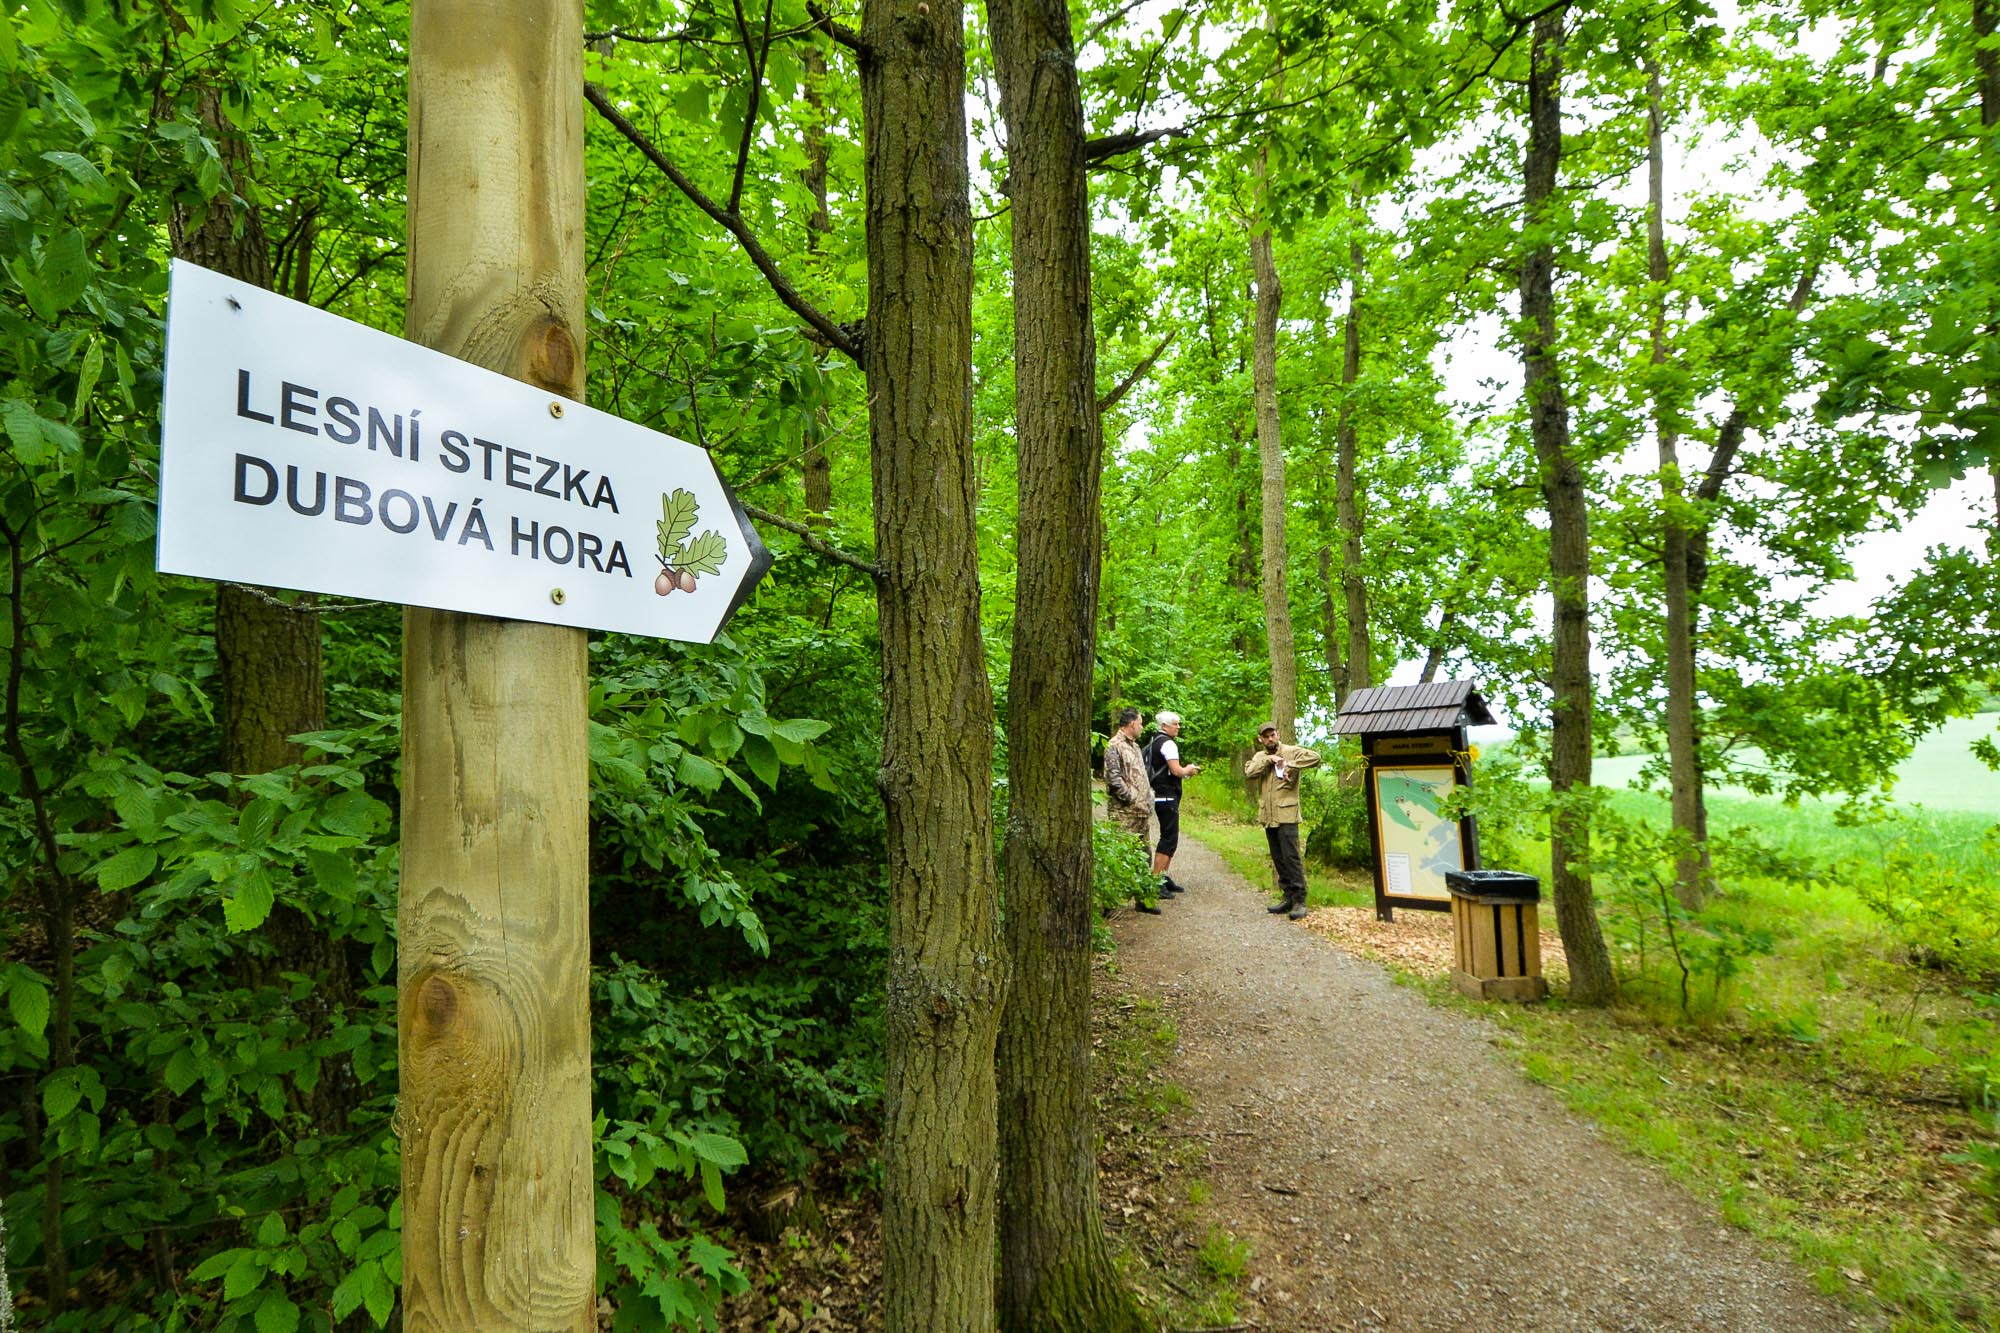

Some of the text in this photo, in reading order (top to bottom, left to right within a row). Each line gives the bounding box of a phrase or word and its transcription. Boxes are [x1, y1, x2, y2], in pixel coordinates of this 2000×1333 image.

[236, 368, 620, 515] LESNÍ STEZKA
[233, 452, 633, 579] DUBOVÁ HORA
